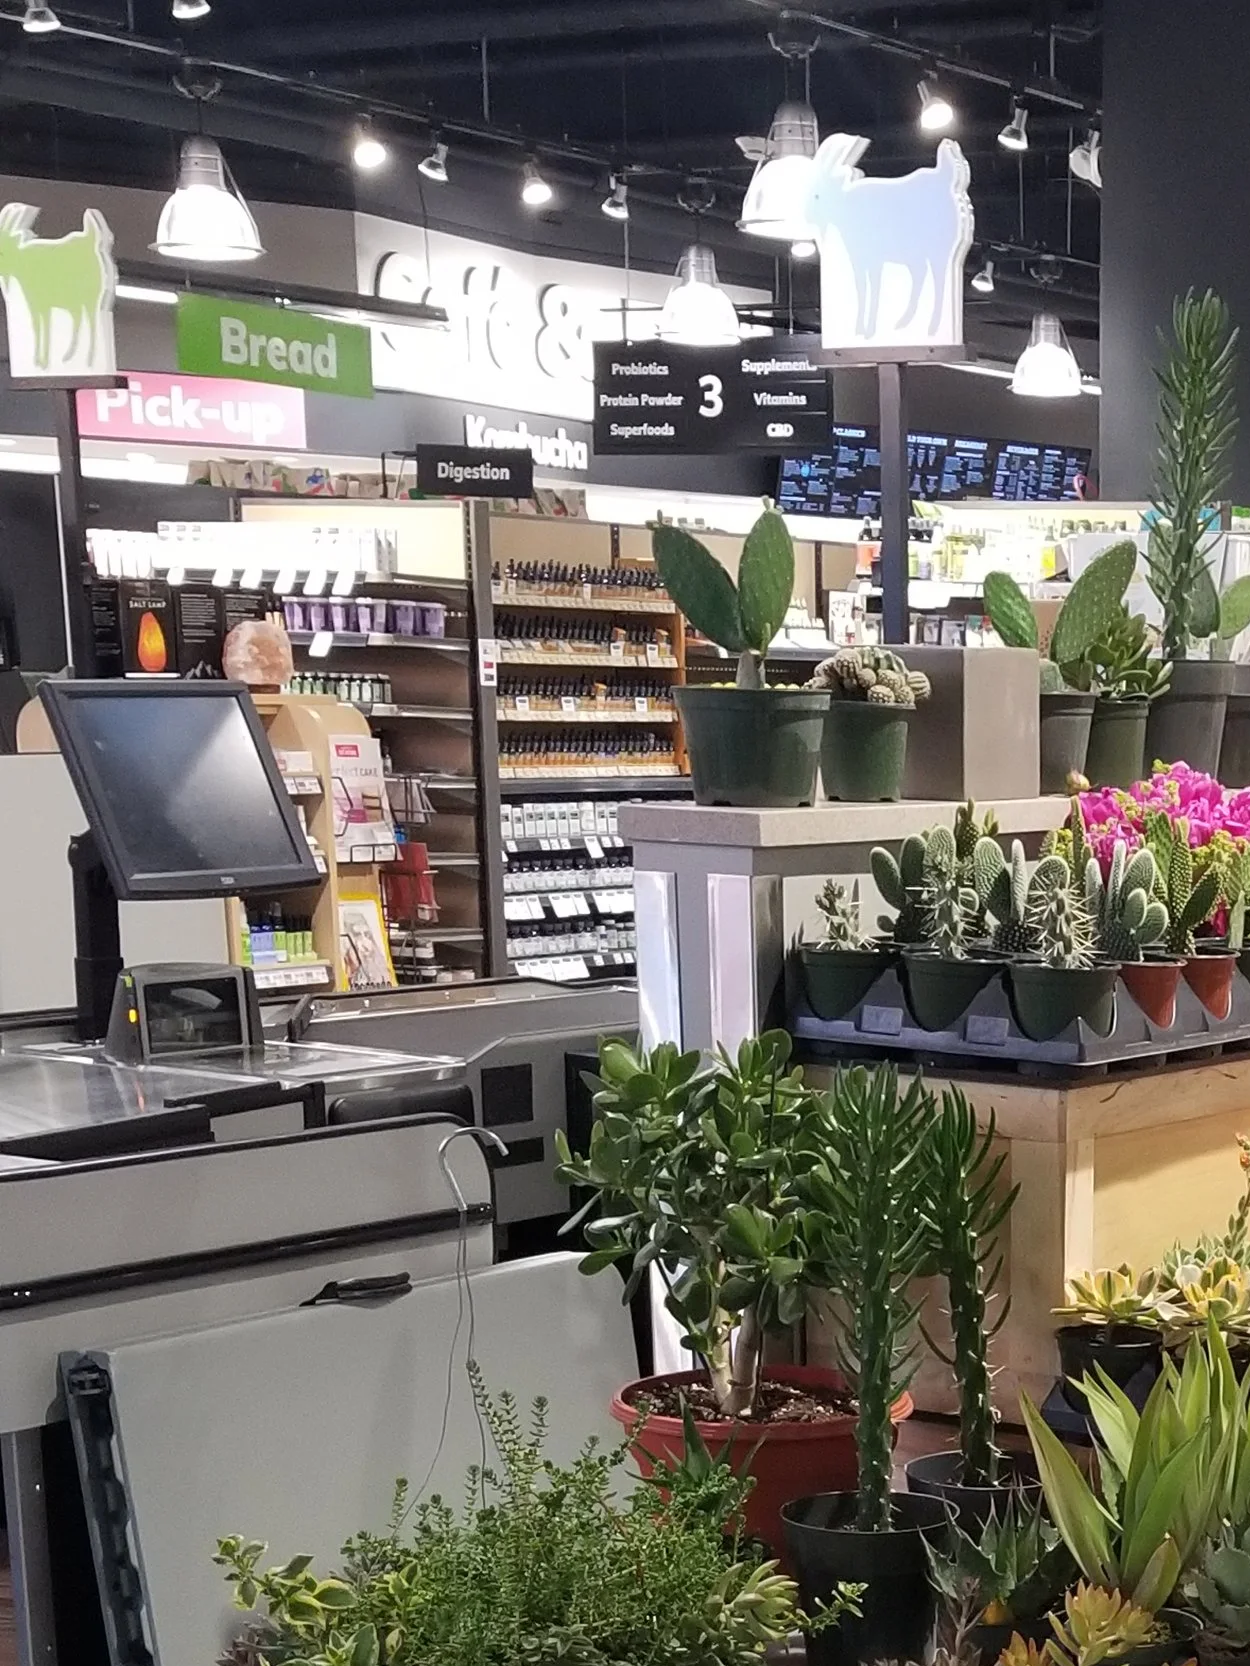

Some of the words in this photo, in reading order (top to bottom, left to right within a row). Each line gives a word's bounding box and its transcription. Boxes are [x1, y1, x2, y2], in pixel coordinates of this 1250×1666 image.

[220, 316, 338, 379] Bread
[612, 362, 669, 376] Probiotics
[600, 393, 639, 407] Protein
[641, 393, 684, 407] Powder
[698, 374, 724, 418] 3
[753, 391, 807, 406] Vitamins
[95, 381, 285, 444] Pick-up
[610, 422, 675, 438] Superfoods
[437, 462, 510, 483] Digestion
